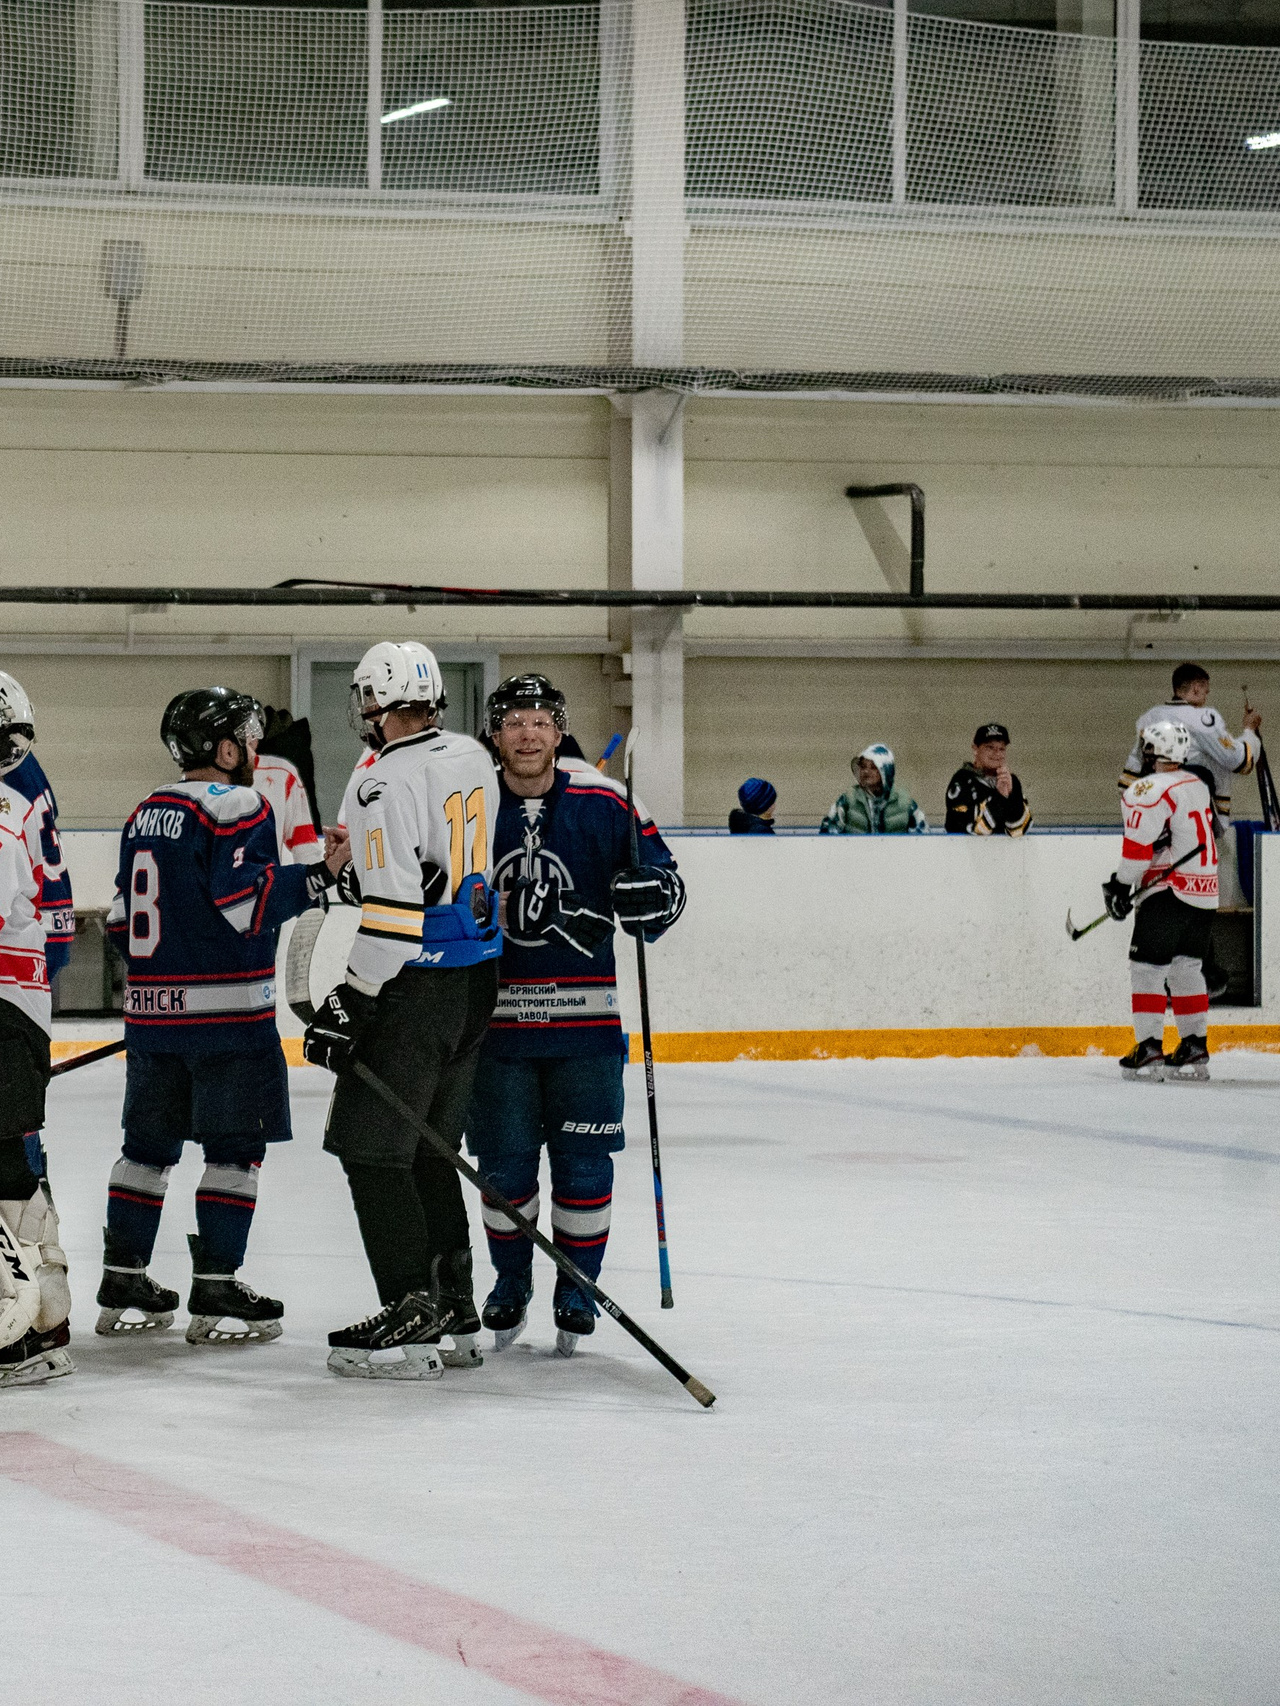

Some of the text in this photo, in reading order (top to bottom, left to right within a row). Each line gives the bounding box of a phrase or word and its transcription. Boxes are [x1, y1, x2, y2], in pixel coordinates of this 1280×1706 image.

[170, 741, 180, 760] 8
[129, 850, 161, 958] 8
[124, 987, 187, 1013] ЯНСК
[509, 983, 557, 995] БРЯНСКИЙ
[518, 1011, 550, 1021] ЗАВОД
[381, 1314, 422, 1348] CCM
